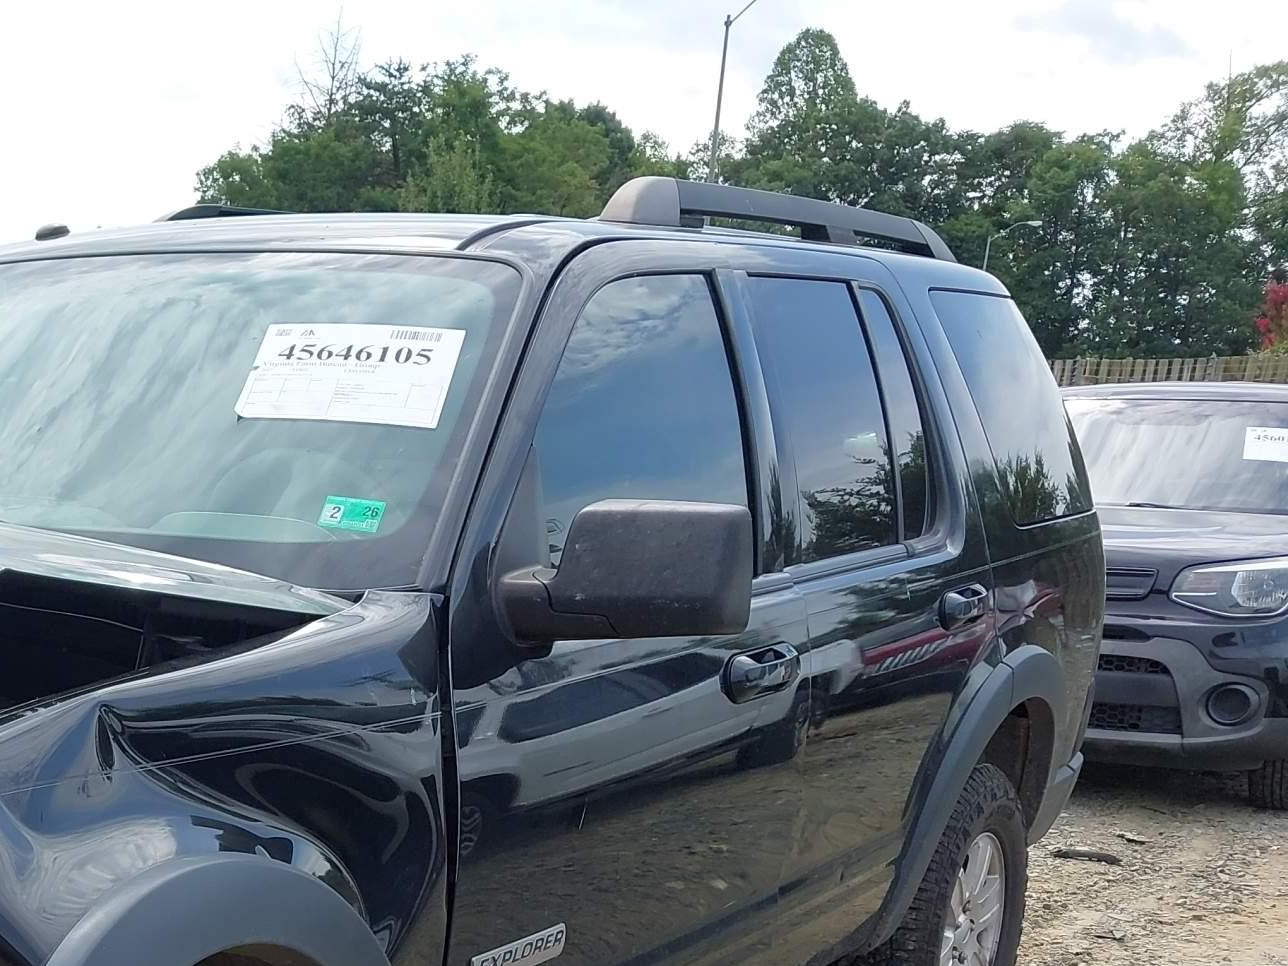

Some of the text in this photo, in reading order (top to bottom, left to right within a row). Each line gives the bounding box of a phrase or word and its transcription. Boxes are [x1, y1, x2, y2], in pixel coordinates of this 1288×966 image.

[277, 343, 435, 366] 45646105
[329, 505, 381, 519] 2 26
